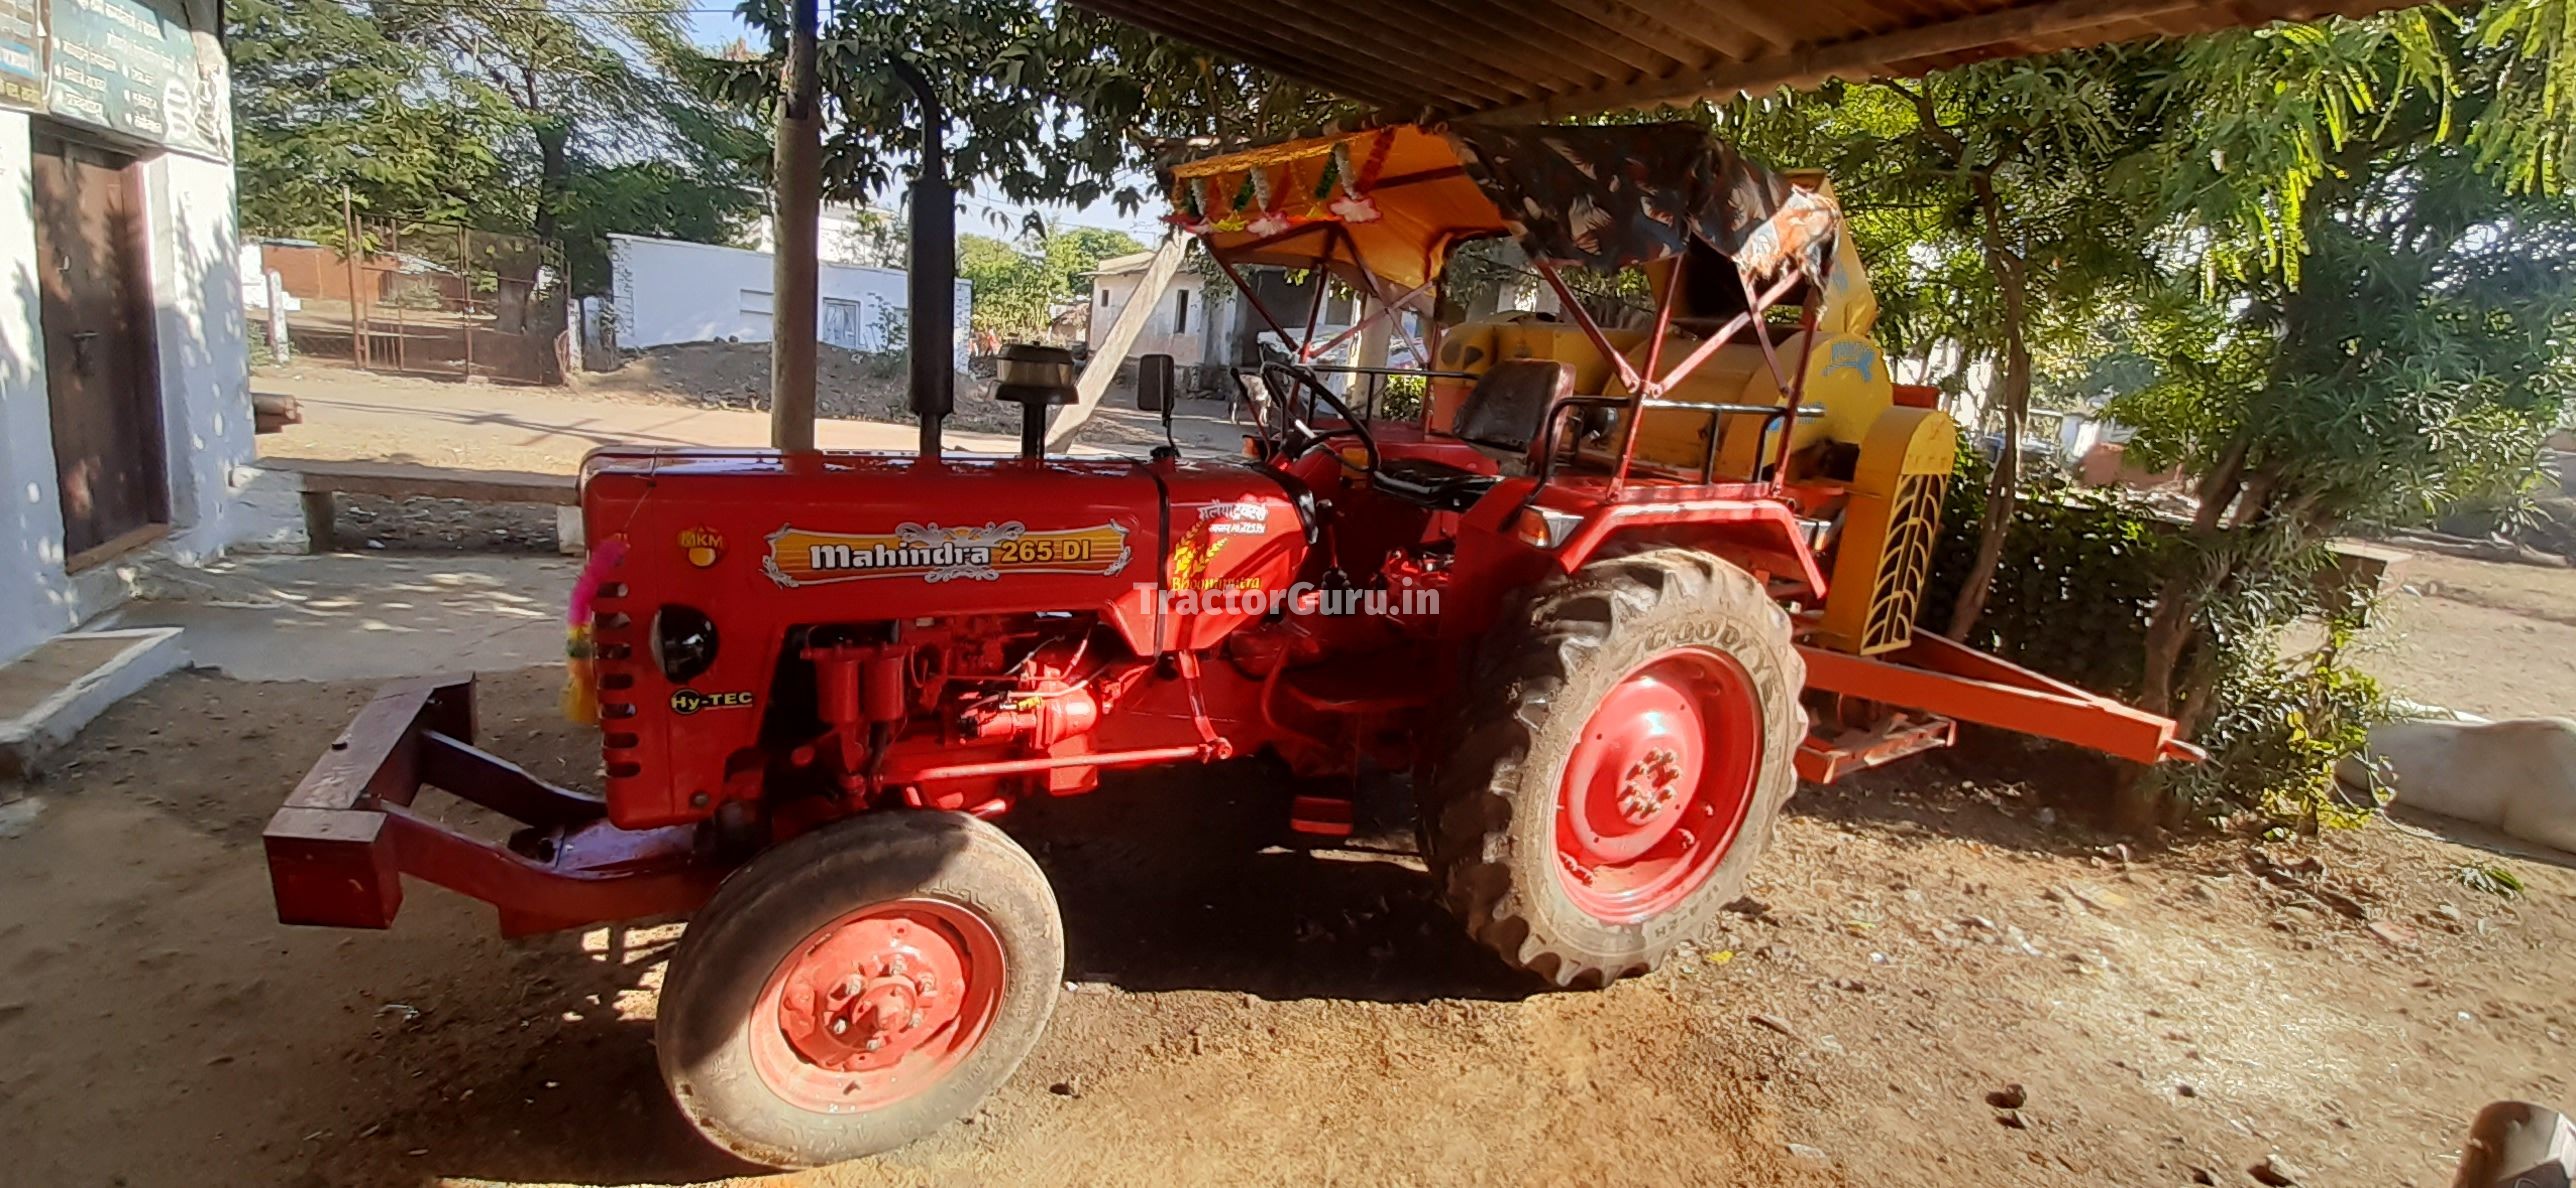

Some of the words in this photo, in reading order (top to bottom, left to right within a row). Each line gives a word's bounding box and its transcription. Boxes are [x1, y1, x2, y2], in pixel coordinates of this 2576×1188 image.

[681, 533, 724, 547] MKM
[810, 541, 990, 569] Mahindra
[1001, 541, 1053, 562] 265
[1062, 540, 1092, 560] DI
[671, 692, 753, 710] Hy-TEC
